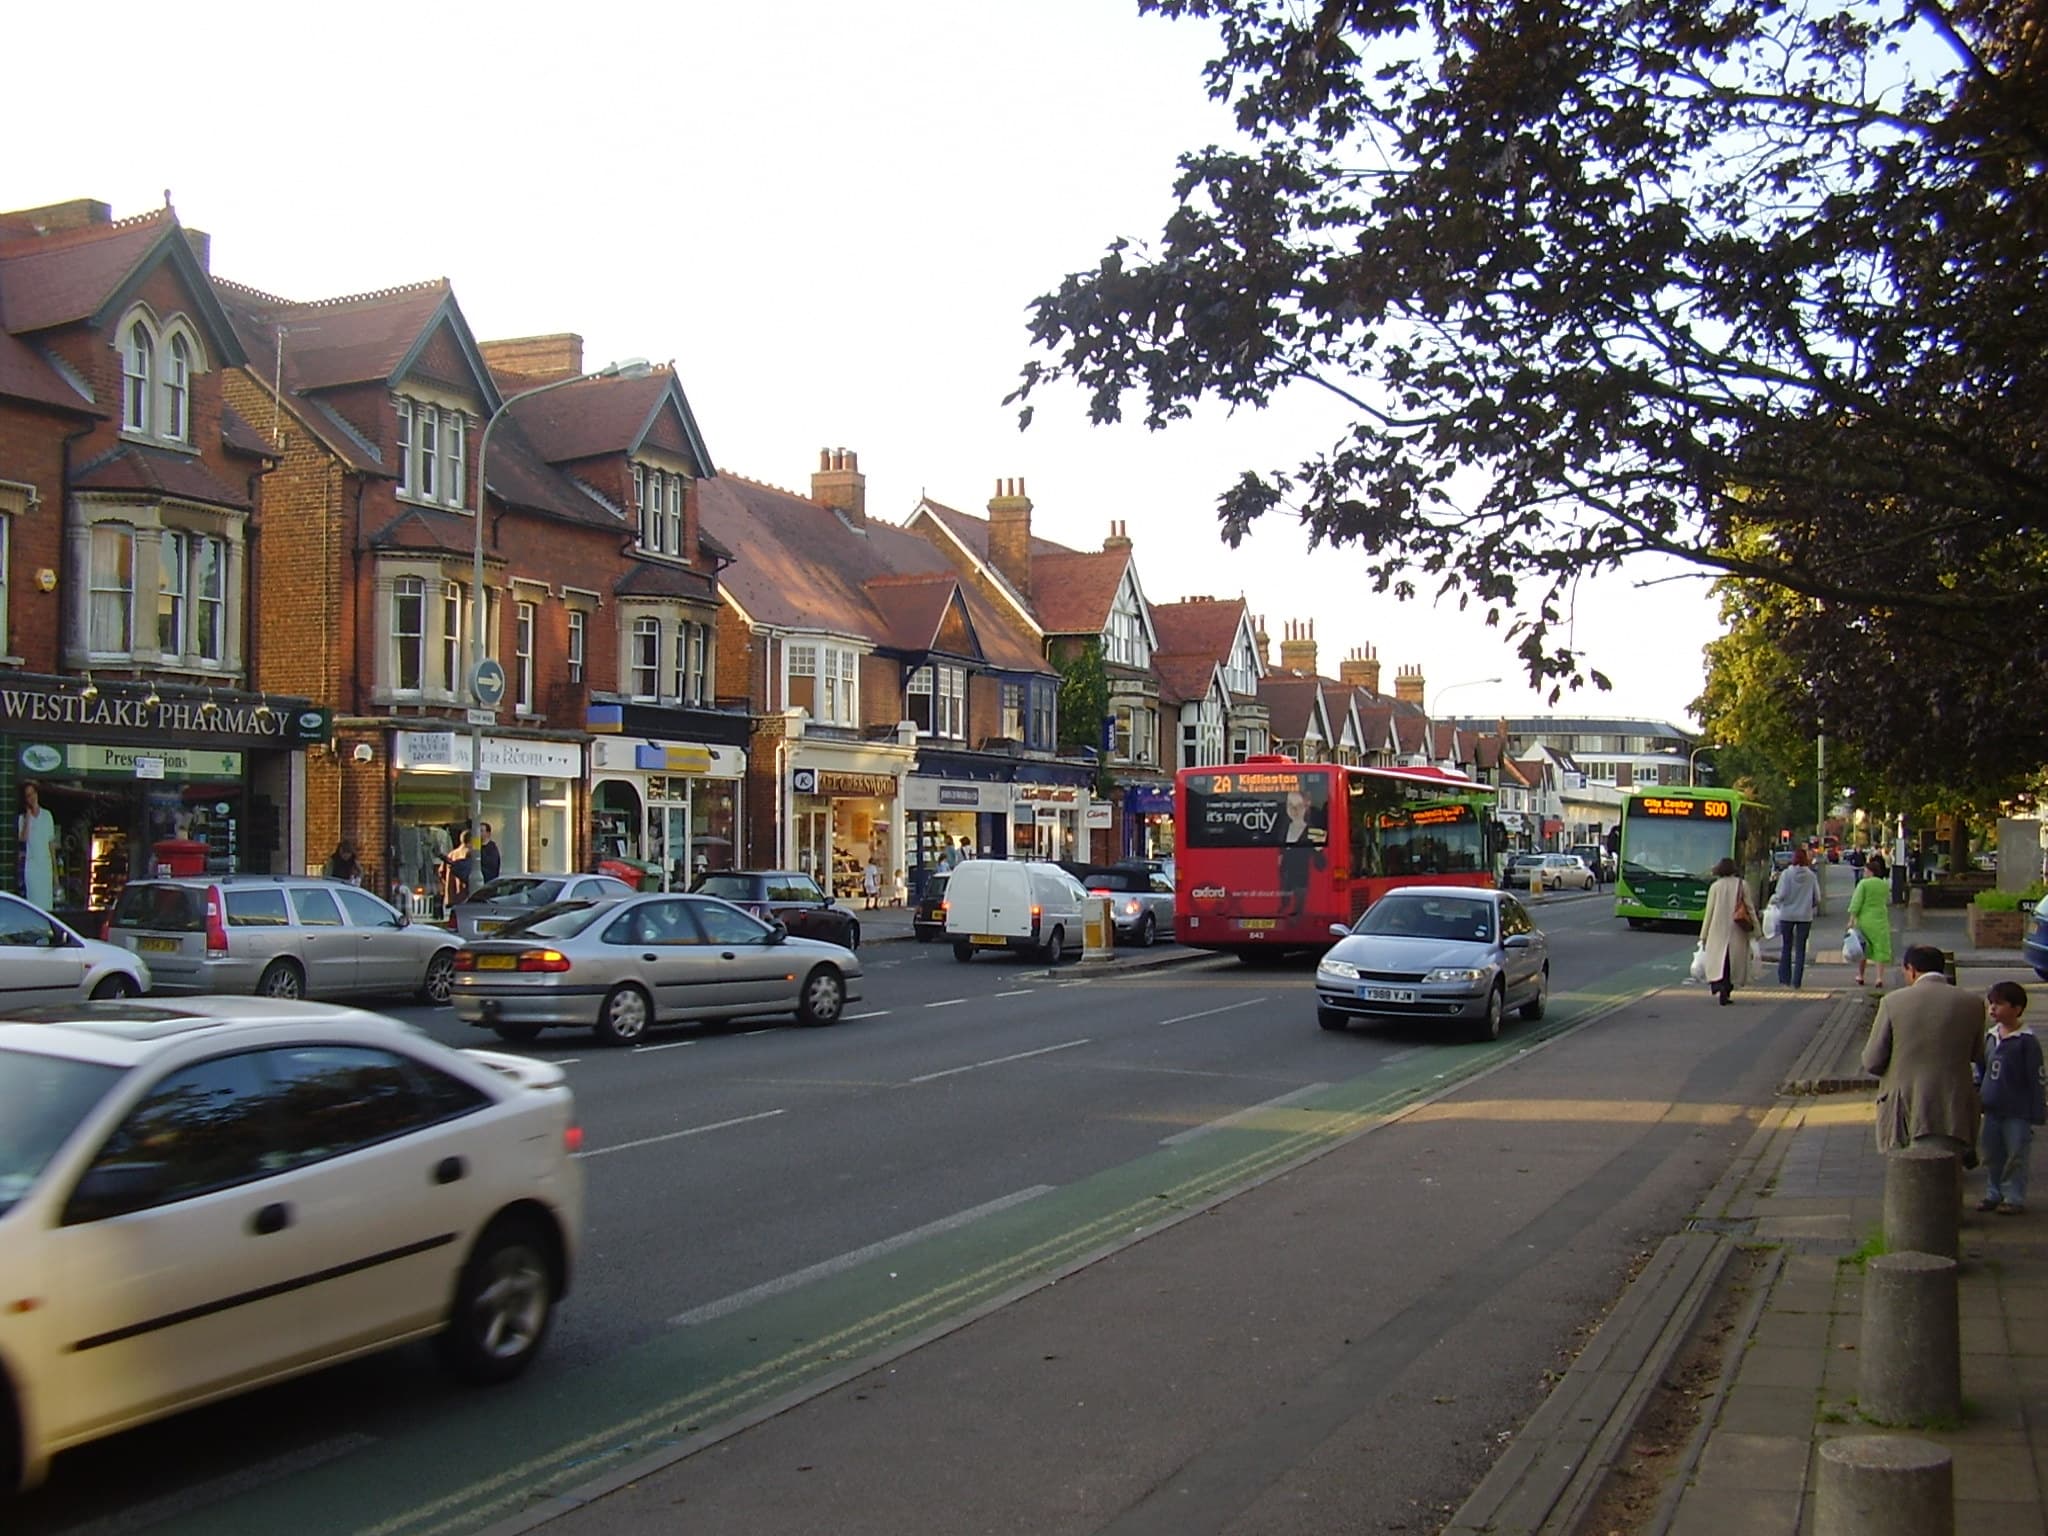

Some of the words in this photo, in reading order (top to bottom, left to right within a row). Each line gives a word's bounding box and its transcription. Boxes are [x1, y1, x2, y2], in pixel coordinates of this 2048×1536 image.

[2, 689, 149, 728] WESTLAKE
[158, 703, 289, 736] PHARMACY
[1212, 775, 1232, 793] 2A
[1239, 774, 1298, 785] Kidlington
[1644, 799, 1662, 808] City
[1663, 799, 1693, 809] Centre
[1704, 801, 1728, 817] 500
[1206, 811, 1223, 822] it's
[1224, 813, 1242, 824] my
[1242, 808, 1278, 833] city
[1192, 886, 1225, 898] oxford
[1991, 1060, 2001, 1080] 9
